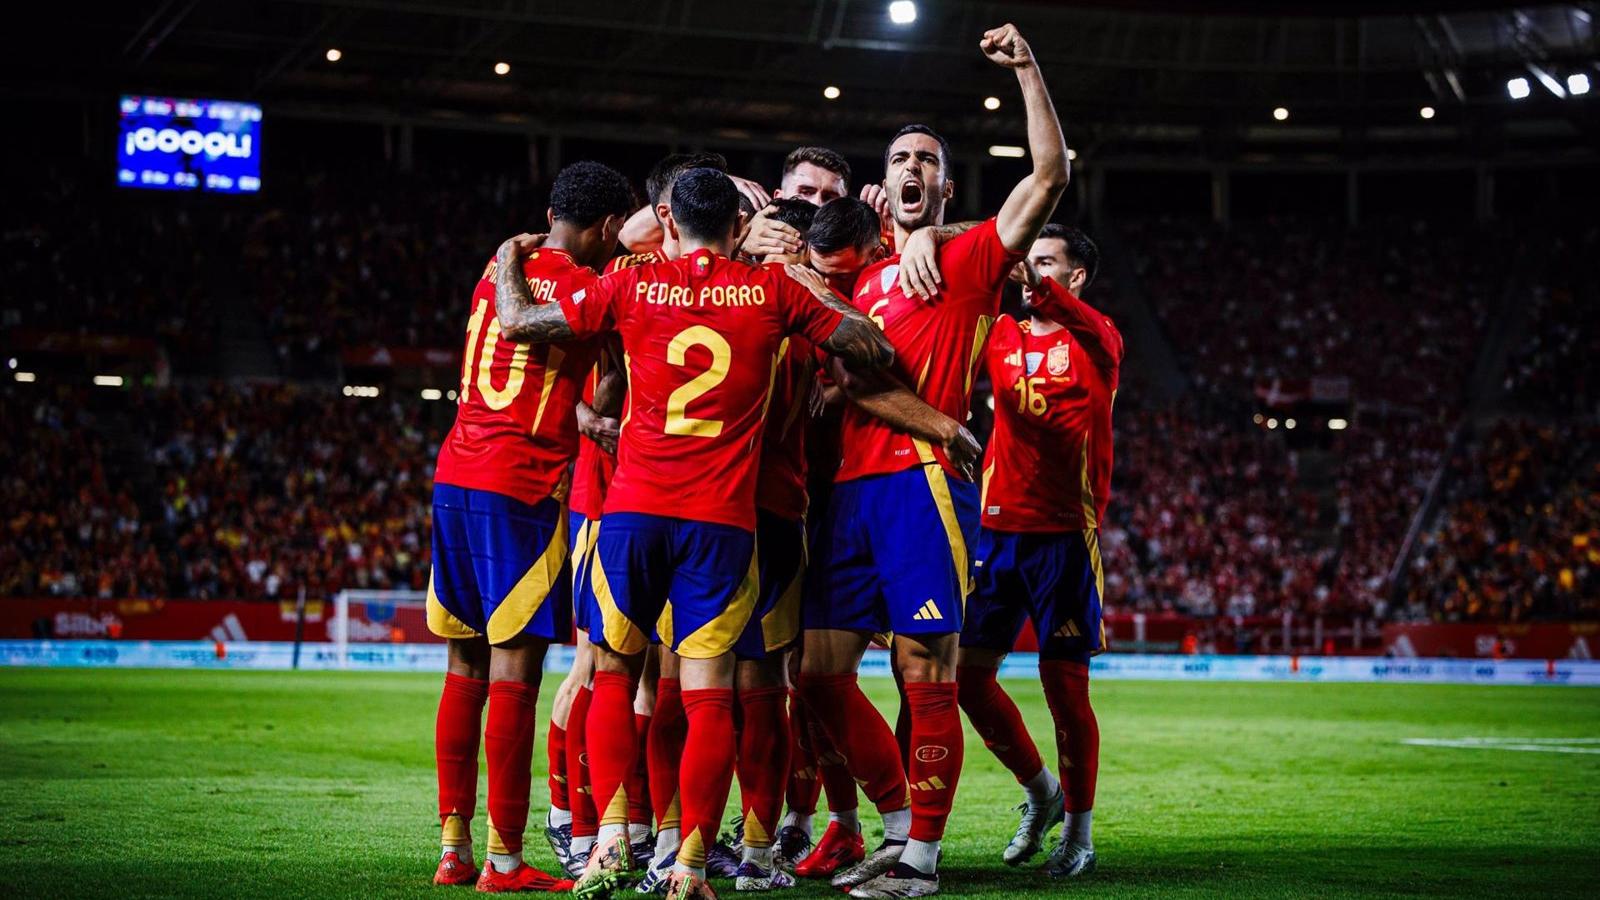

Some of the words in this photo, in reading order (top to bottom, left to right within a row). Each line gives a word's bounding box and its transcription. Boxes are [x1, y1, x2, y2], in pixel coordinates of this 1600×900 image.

[635, 281, 694, 307] PEDRO
[699, 285, 766, 307] PORRO
[460, 298, 530, 411] 10
[664, 325, 731, 437] 2
[1014, 376, 1047, 416] 16
